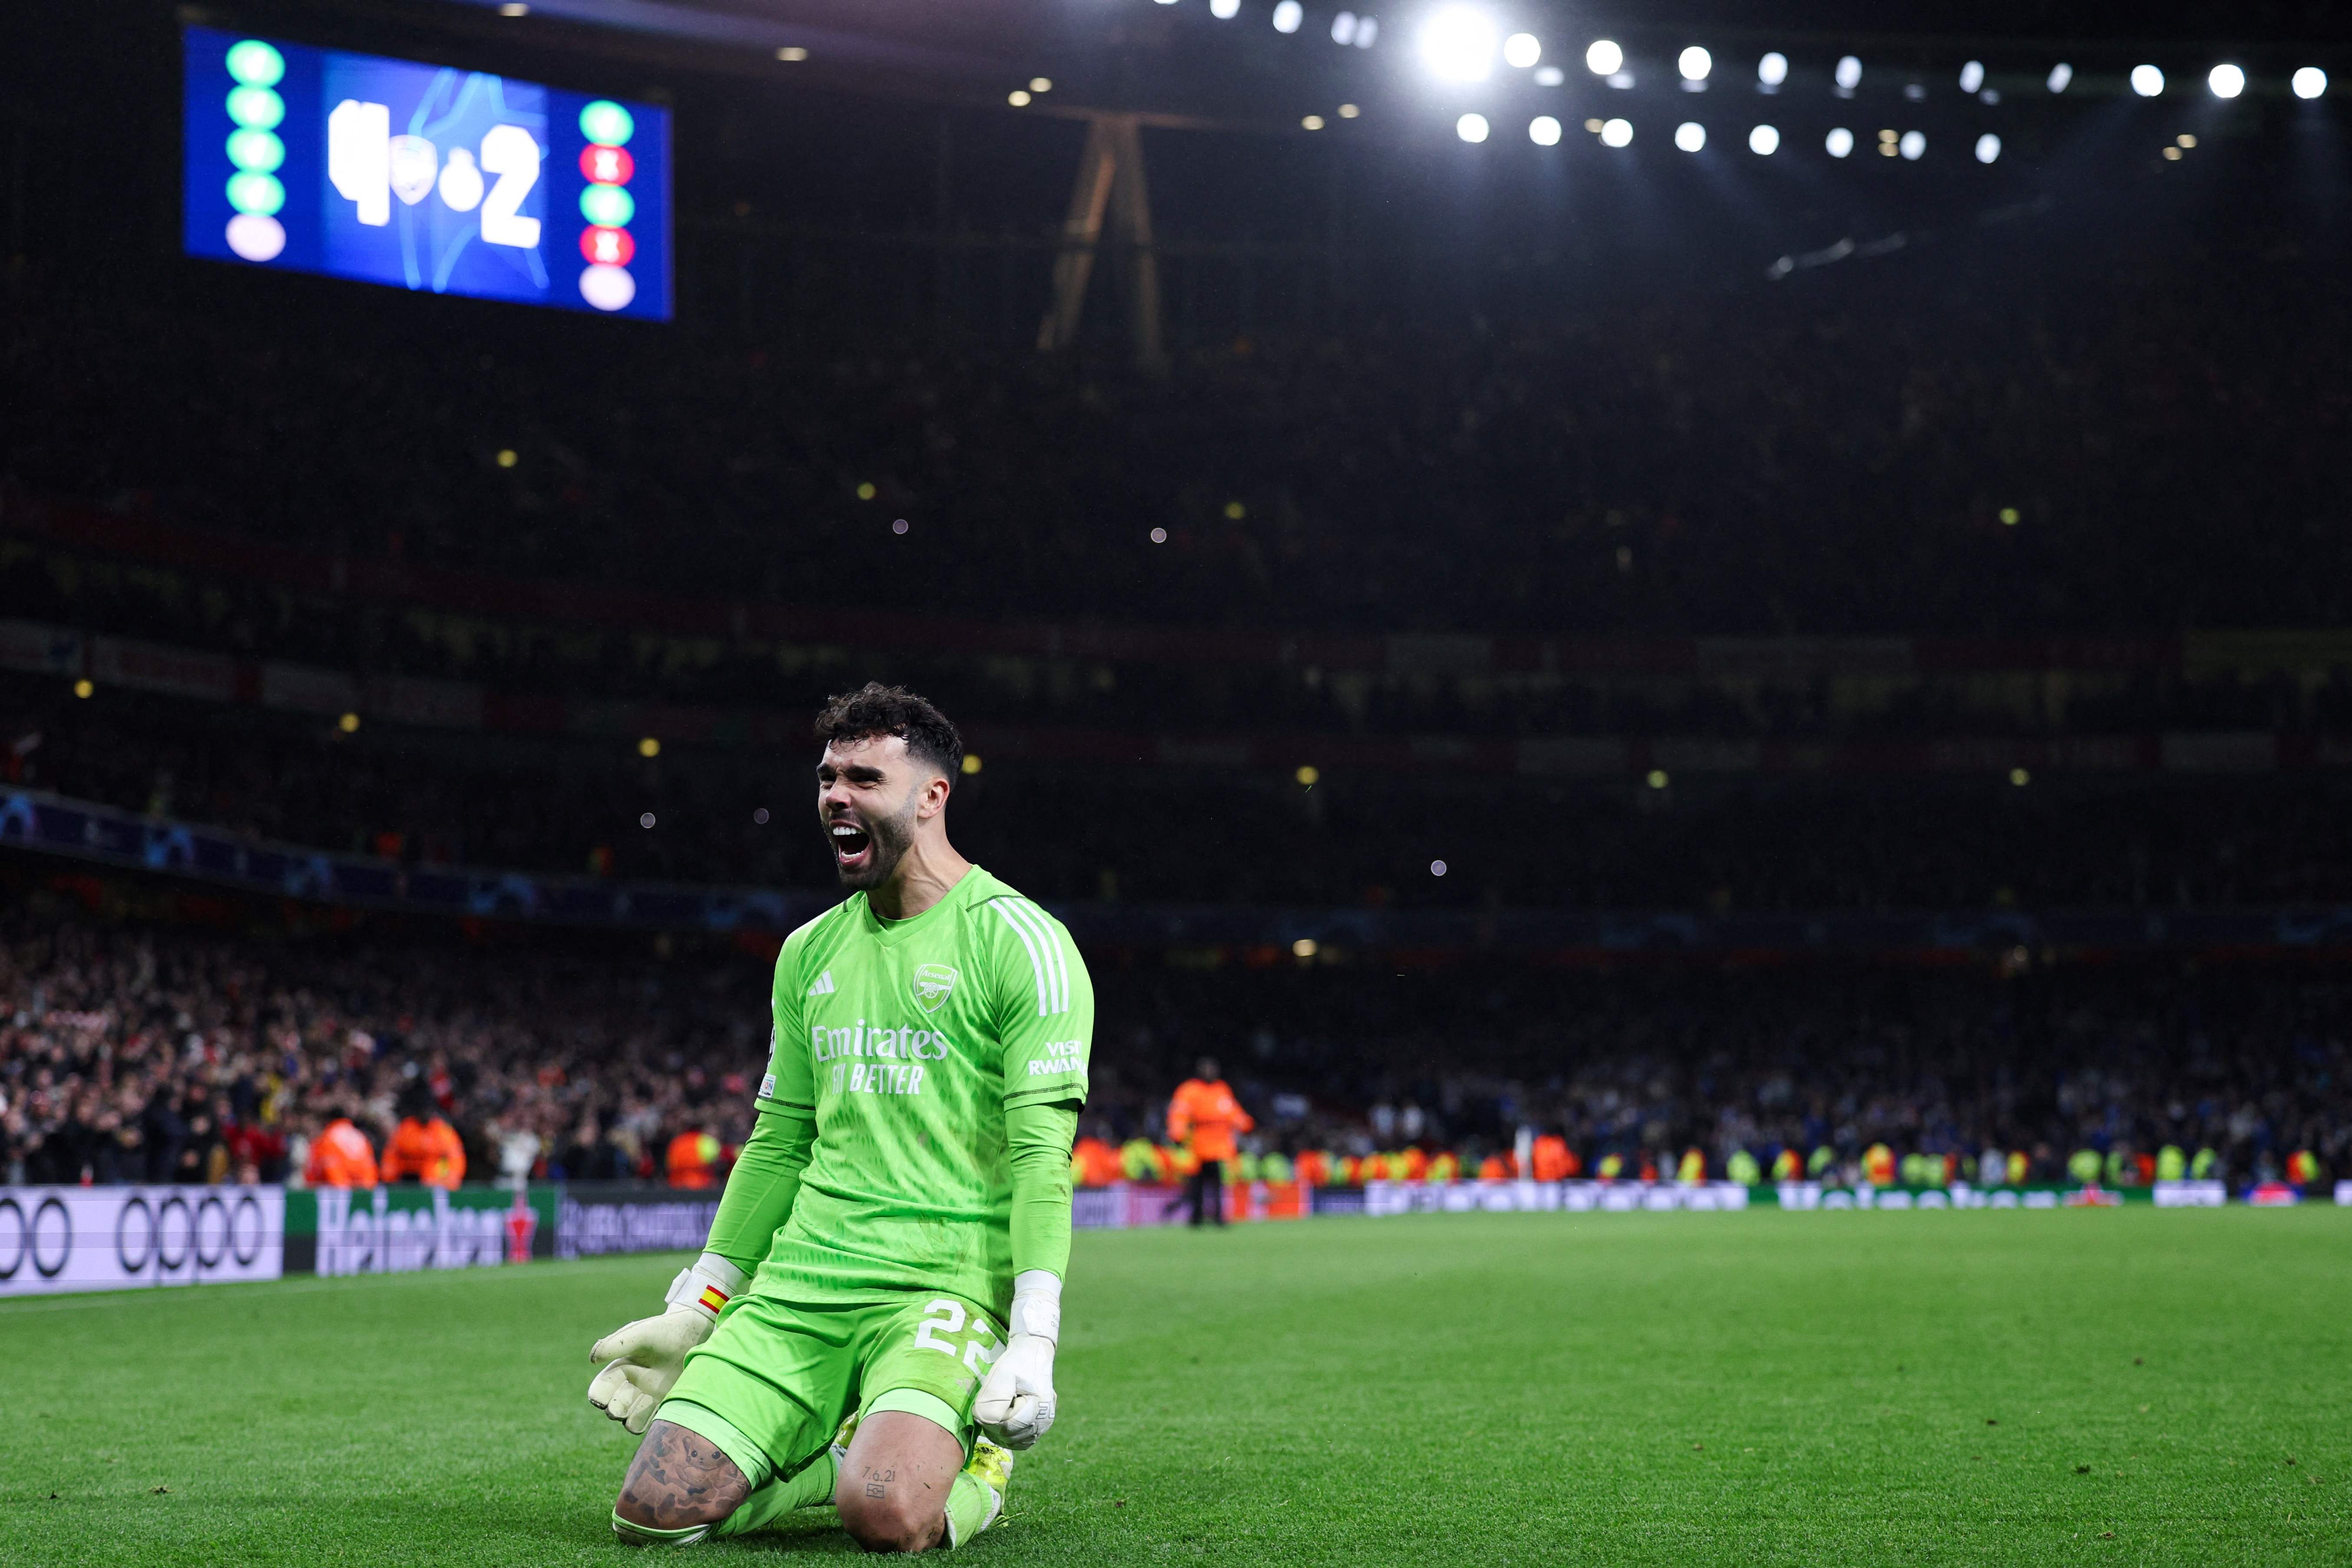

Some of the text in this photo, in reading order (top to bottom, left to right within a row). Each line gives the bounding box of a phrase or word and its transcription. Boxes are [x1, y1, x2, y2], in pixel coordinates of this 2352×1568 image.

[328, 99, 541, 249] 4 2
[921, 970, 951, 981] Arsenal
[811, 1018, 947, 1062] Emirates
[849, 1063, 924, 1094] BETTER
[116, 1196, 265, 1285] oppo
[914, 1298, 1007, 1386] 22
[862, 1466, 895, 1482] 7.6.21
